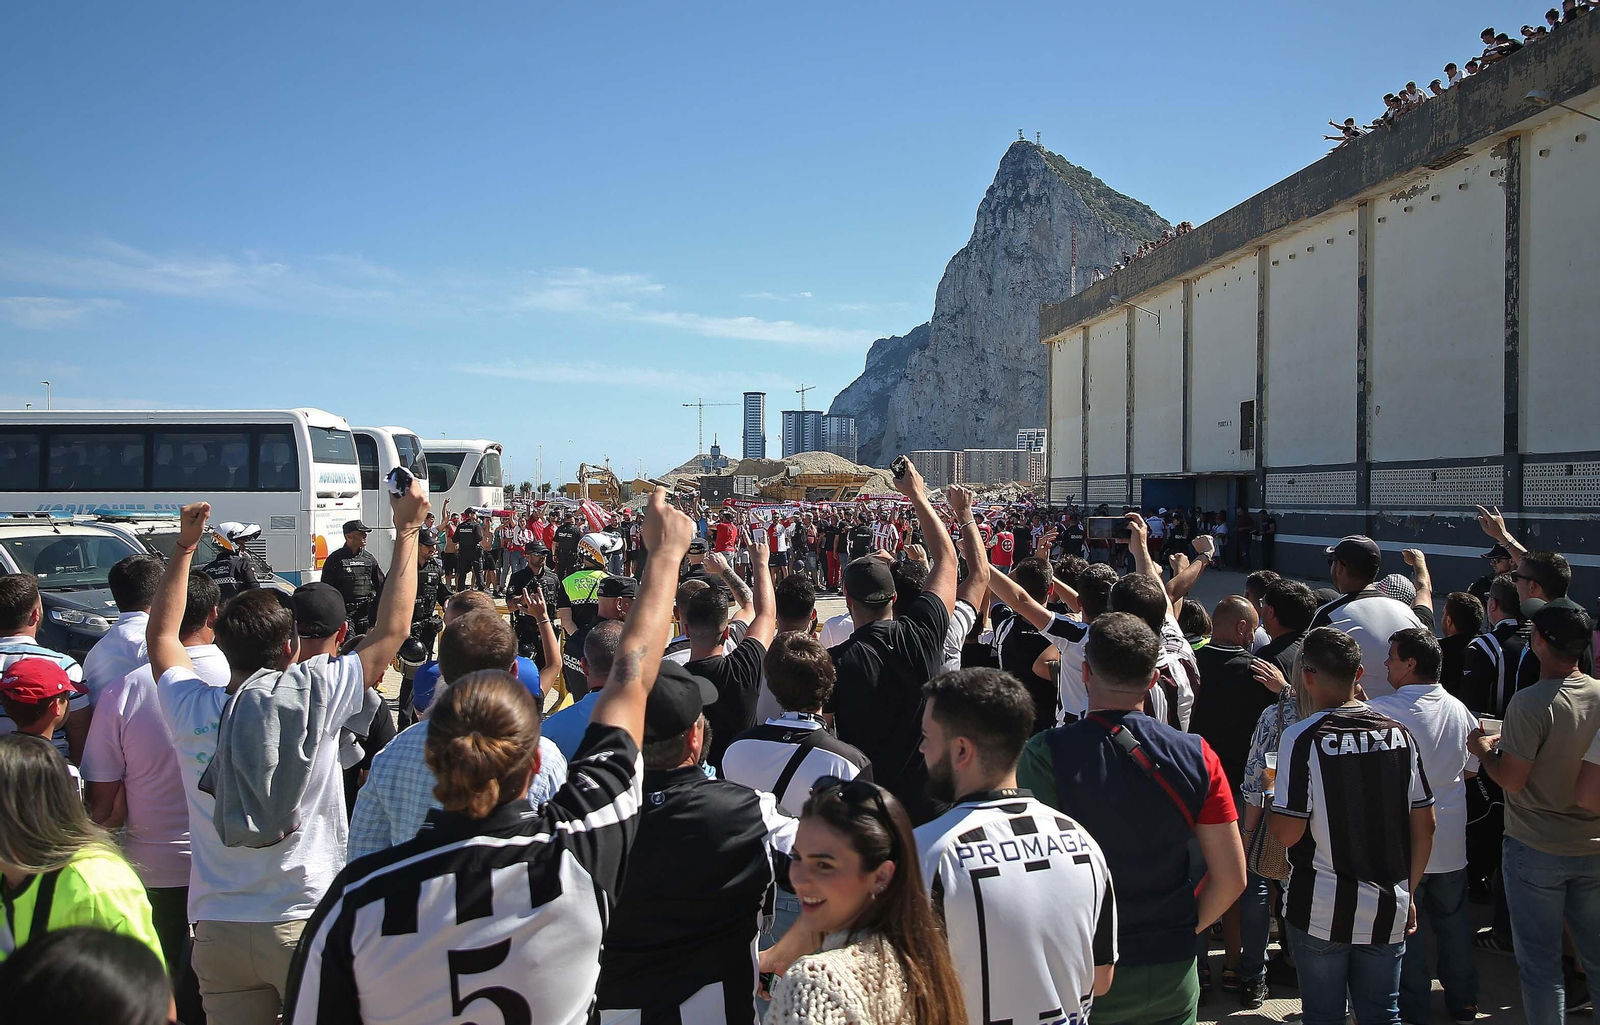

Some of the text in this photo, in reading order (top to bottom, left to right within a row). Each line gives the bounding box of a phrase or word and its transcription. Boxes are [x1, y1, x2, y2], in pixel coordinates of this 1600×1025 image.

[319, 472, 357, 484] HORIZONTE SUR
[581, 541, 597, 555] LOCAL
[1321, 727, 1407, 756] CAIXA
[956, 832, 1093, 868] PROMAGA
[448, 936, 533, 1025] 5
